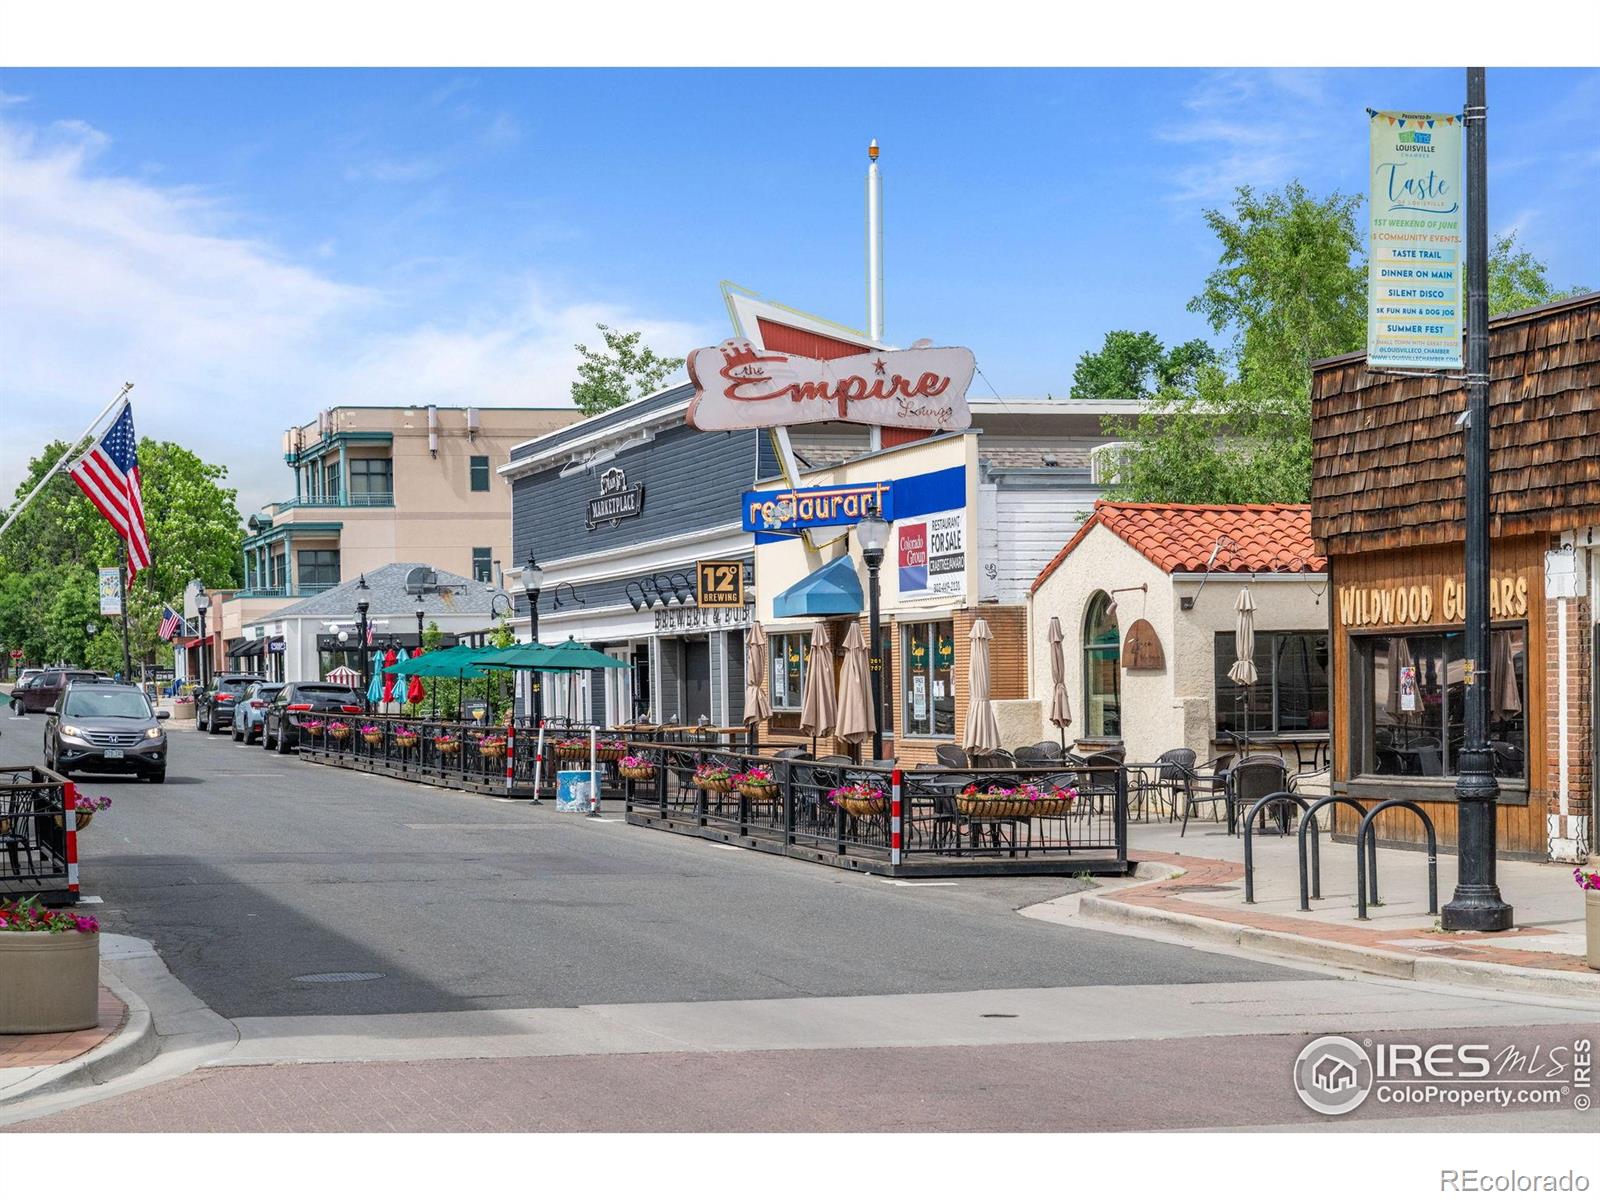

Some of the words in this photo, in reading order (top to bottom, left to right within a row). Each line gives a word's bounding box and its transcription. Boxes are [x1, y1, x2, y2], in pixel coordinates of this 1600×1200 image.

[1395, 145, 1435, 153] LOUISVILLE
[1376, 162, 1450, 201] Taste
[1374, 219, 1386, 227] 1ST
[1388, 219, 1425, 228] WEEKEND
[1438, 221, 1458, 230] JUNE
[1379, 233, 1428, 241] COMMUNITY
[1392, 250, 1416, 258] TASTE
[1419, 251, 1441, 259] TRAIL
[1381, 269, 1413, 277] DINNER
[1416, 270, 1428, 278] ON
[1431, 271, 1453, 279] MAIN
[1388, 289, 1416, 297] SILENT
[1420, 290, 1444, 298] DISCO
[1387, 325, 1422, 333] SUMMER
[1425, 326, 1444, 334] FEST
[734, 365, 764, 378] the
[719, 350, 951, 418] Empire
[897, 399, 953, 424] Lounge
[591, 493, 635, 519] MARKETPLACE
[750, 482, 890, 525] restaurant
[931, 515, 961, 532] RESTAURANT
[900, 534, 924, 552] Colorado
[931, 532, 945, 554] FOR
[945, 529, 962, 552] SALE
[907, 549, 926, 568] Group
[703, 592, 738, 602] BREWING
[1339, 584, 1433, 626] WILDWOOD
[1443, 576, 1528, 622] GUARS
[654, 606, 708, 629] BREWERY
[713, 608, 721, 624] &
[725, 604, 750, 623] PUB
